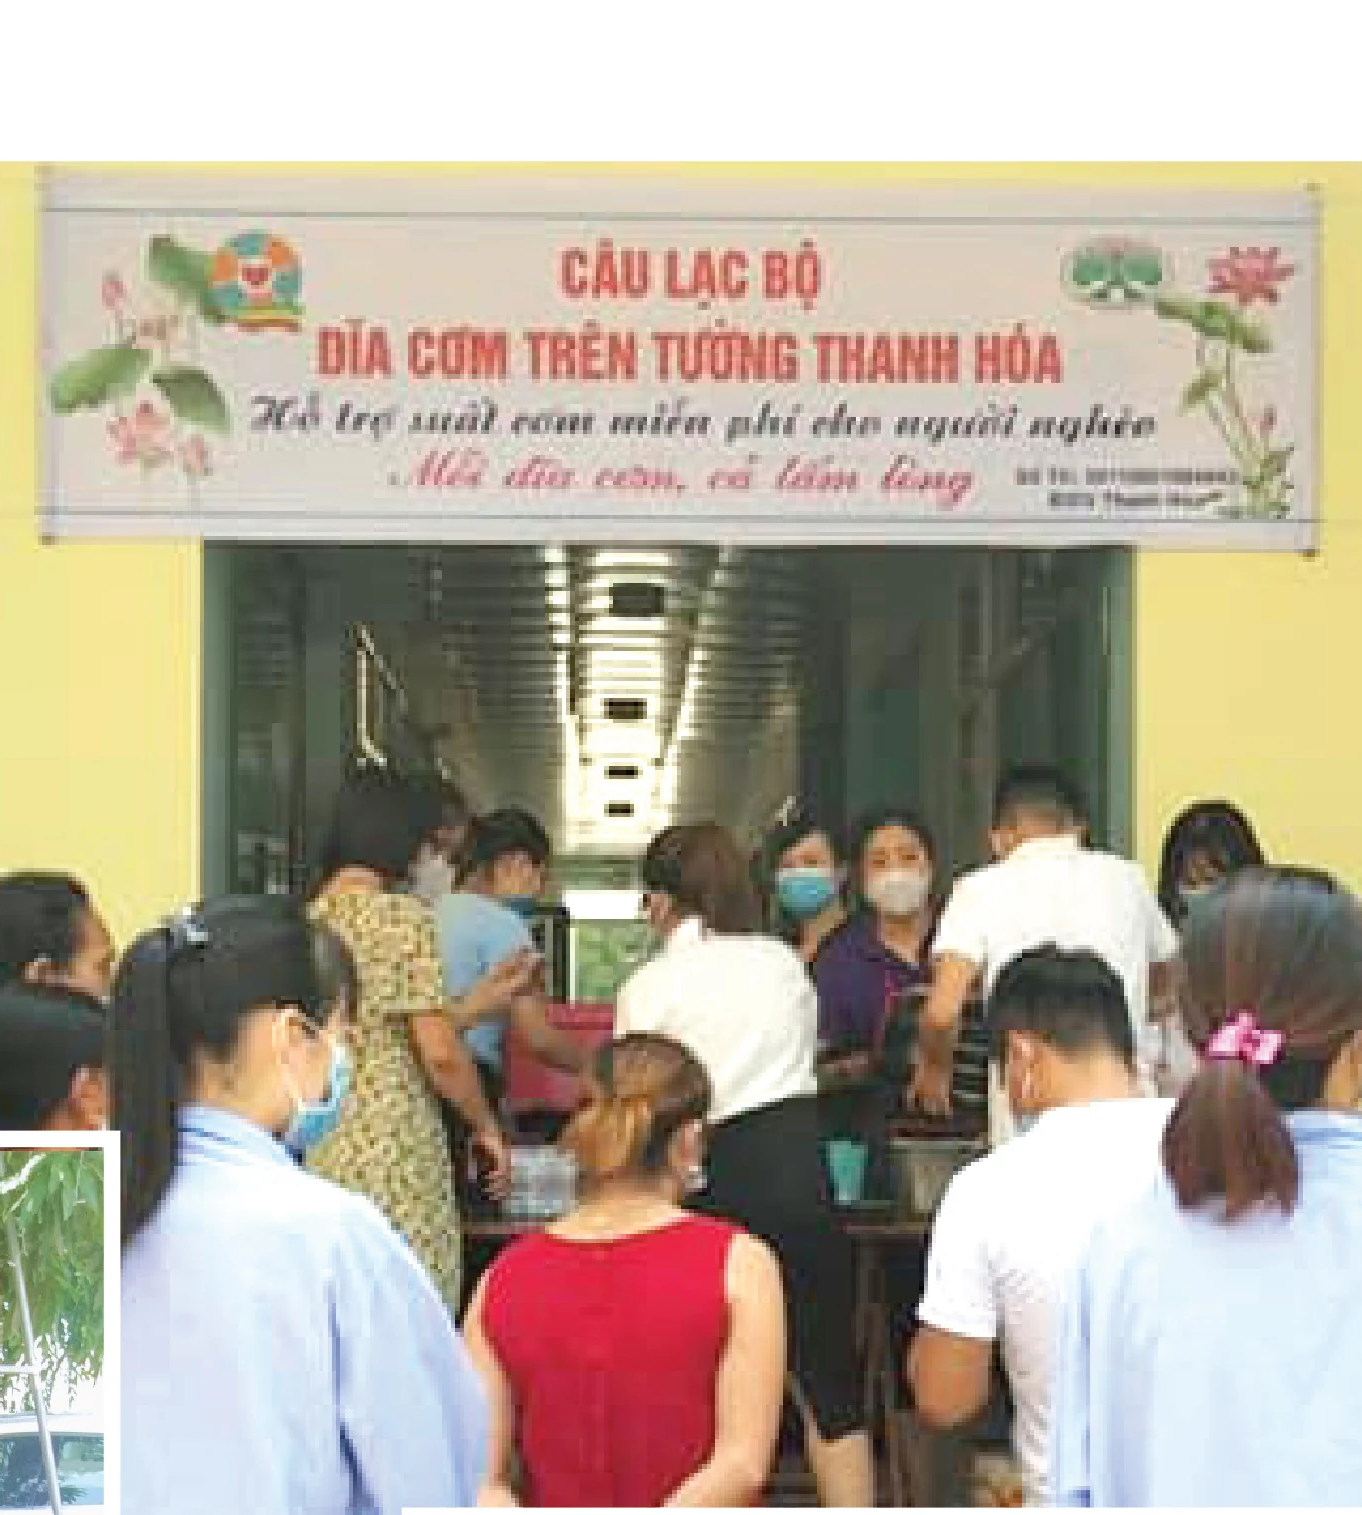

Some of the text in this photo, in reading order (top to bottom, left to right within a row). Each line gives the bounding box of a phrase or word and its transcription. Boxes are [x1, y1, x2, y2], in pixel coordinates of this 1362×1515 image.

[561, 238, 821, 310] CÂU LẠC BỘ
[408, 323, 508, 379] CƠM
[524, 319, 635, 380] TRÊN
[651, 319, 798, 381] TƯỜNG
[813, 331, 959, 382] THANH
[974, 323, 1065, 383] HÓA
